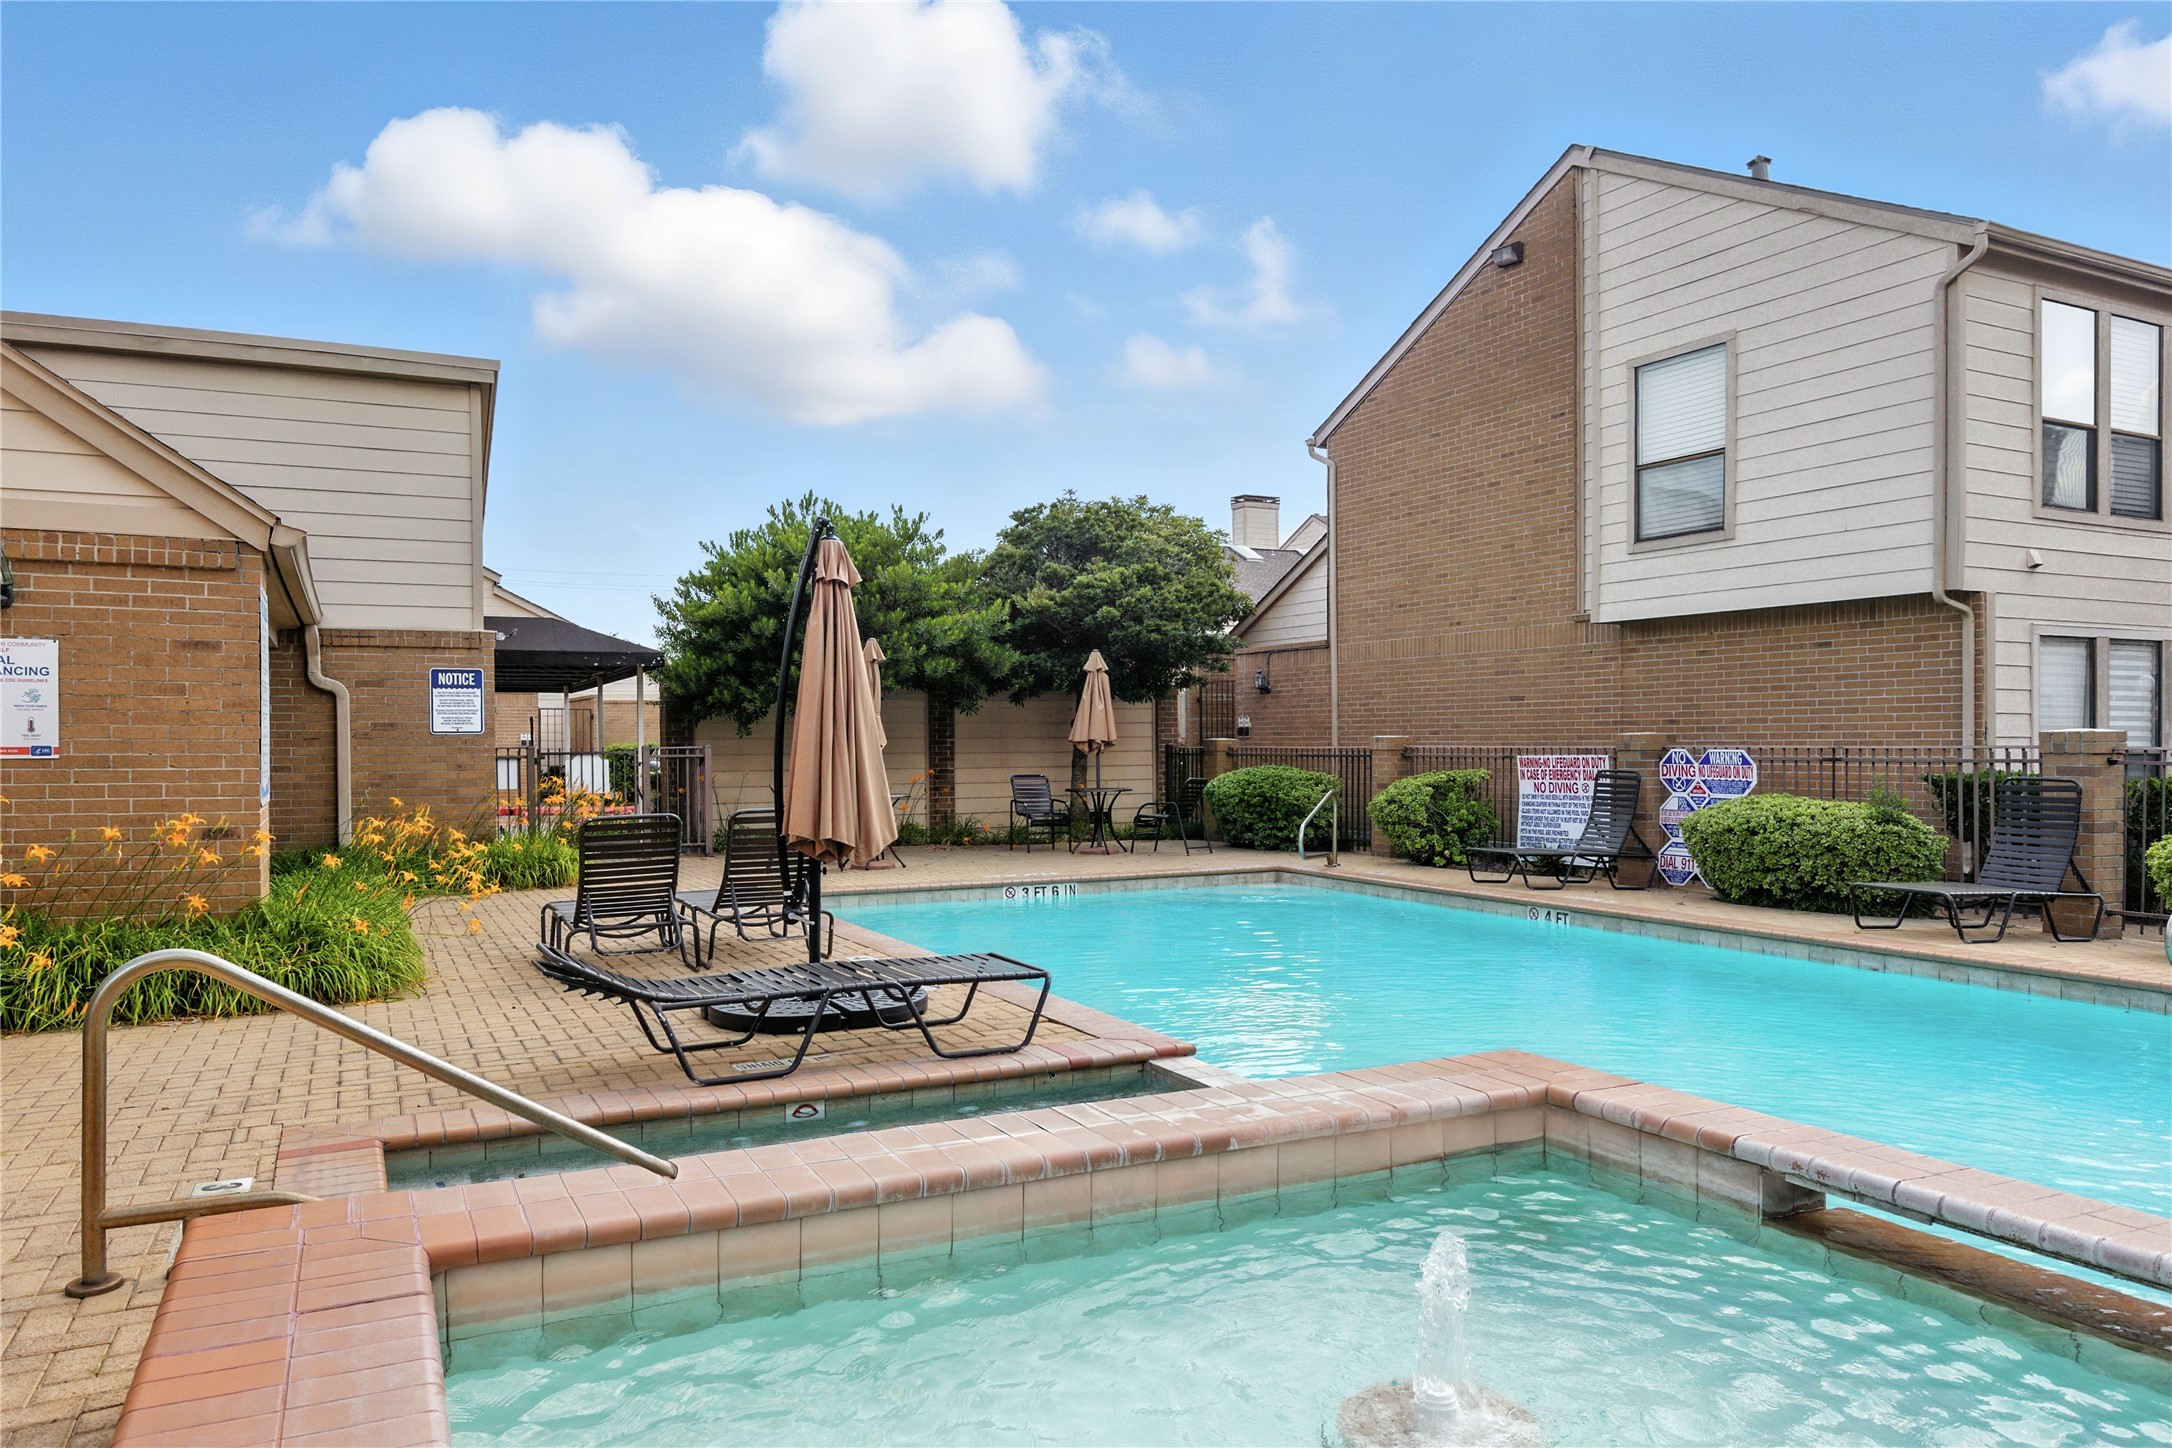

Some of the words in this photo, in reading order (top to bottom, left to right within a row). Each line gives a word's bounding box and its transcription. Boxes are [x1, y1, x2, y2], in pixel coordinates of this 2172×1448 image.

[0, 666, 50, 676] NCING
[438, 672, 475, 685] NOTICE
[1519, 757, 1551, 768] WARNING-NO
[1552, 757, 1580, 768] LIFEGUARD
[1582, 757, 1590, 768] ON
[1591, 757, 1606, 768] DUTY
[1671, 752, 1686, 764] NO
[1709, 751, 1743, 765] WARNING
[1520, 769, 1526, 780] IN
[1526, 769, 1539, 780] CASE
[1541, 769, 1548, 780] OF
[1548, 769, 1581, 780] EMERGENCY
[1582, 770, 1595, 781] DIAL
[1661, 764, 1696, 777] DIVING
[1698, 766, 1706, 778] NO
[1706, 766, 1732, 778] LIFEGUARD
[1733, 767, 1740, 779] ON
[1741, 767, 1754, 779] DUTY
[1533, 782, 1547, 794] NO
[1548, 782, 1579, 794] DIVING
[1660, 856, 1678, 869] DIAL
[1681, 857, 1695, 870] 911
[1022, 887, 1030, 898] 3
[1034, 886, 1047, 897] FT
[1052, 885, 1060, 897] 6
[1064, 884, 1076, 896] IN
[1544, 910, 1552, 921] 4
[1556, 911, 1569, 925] FT
[736, 1060, 784, 1070] DIVING
